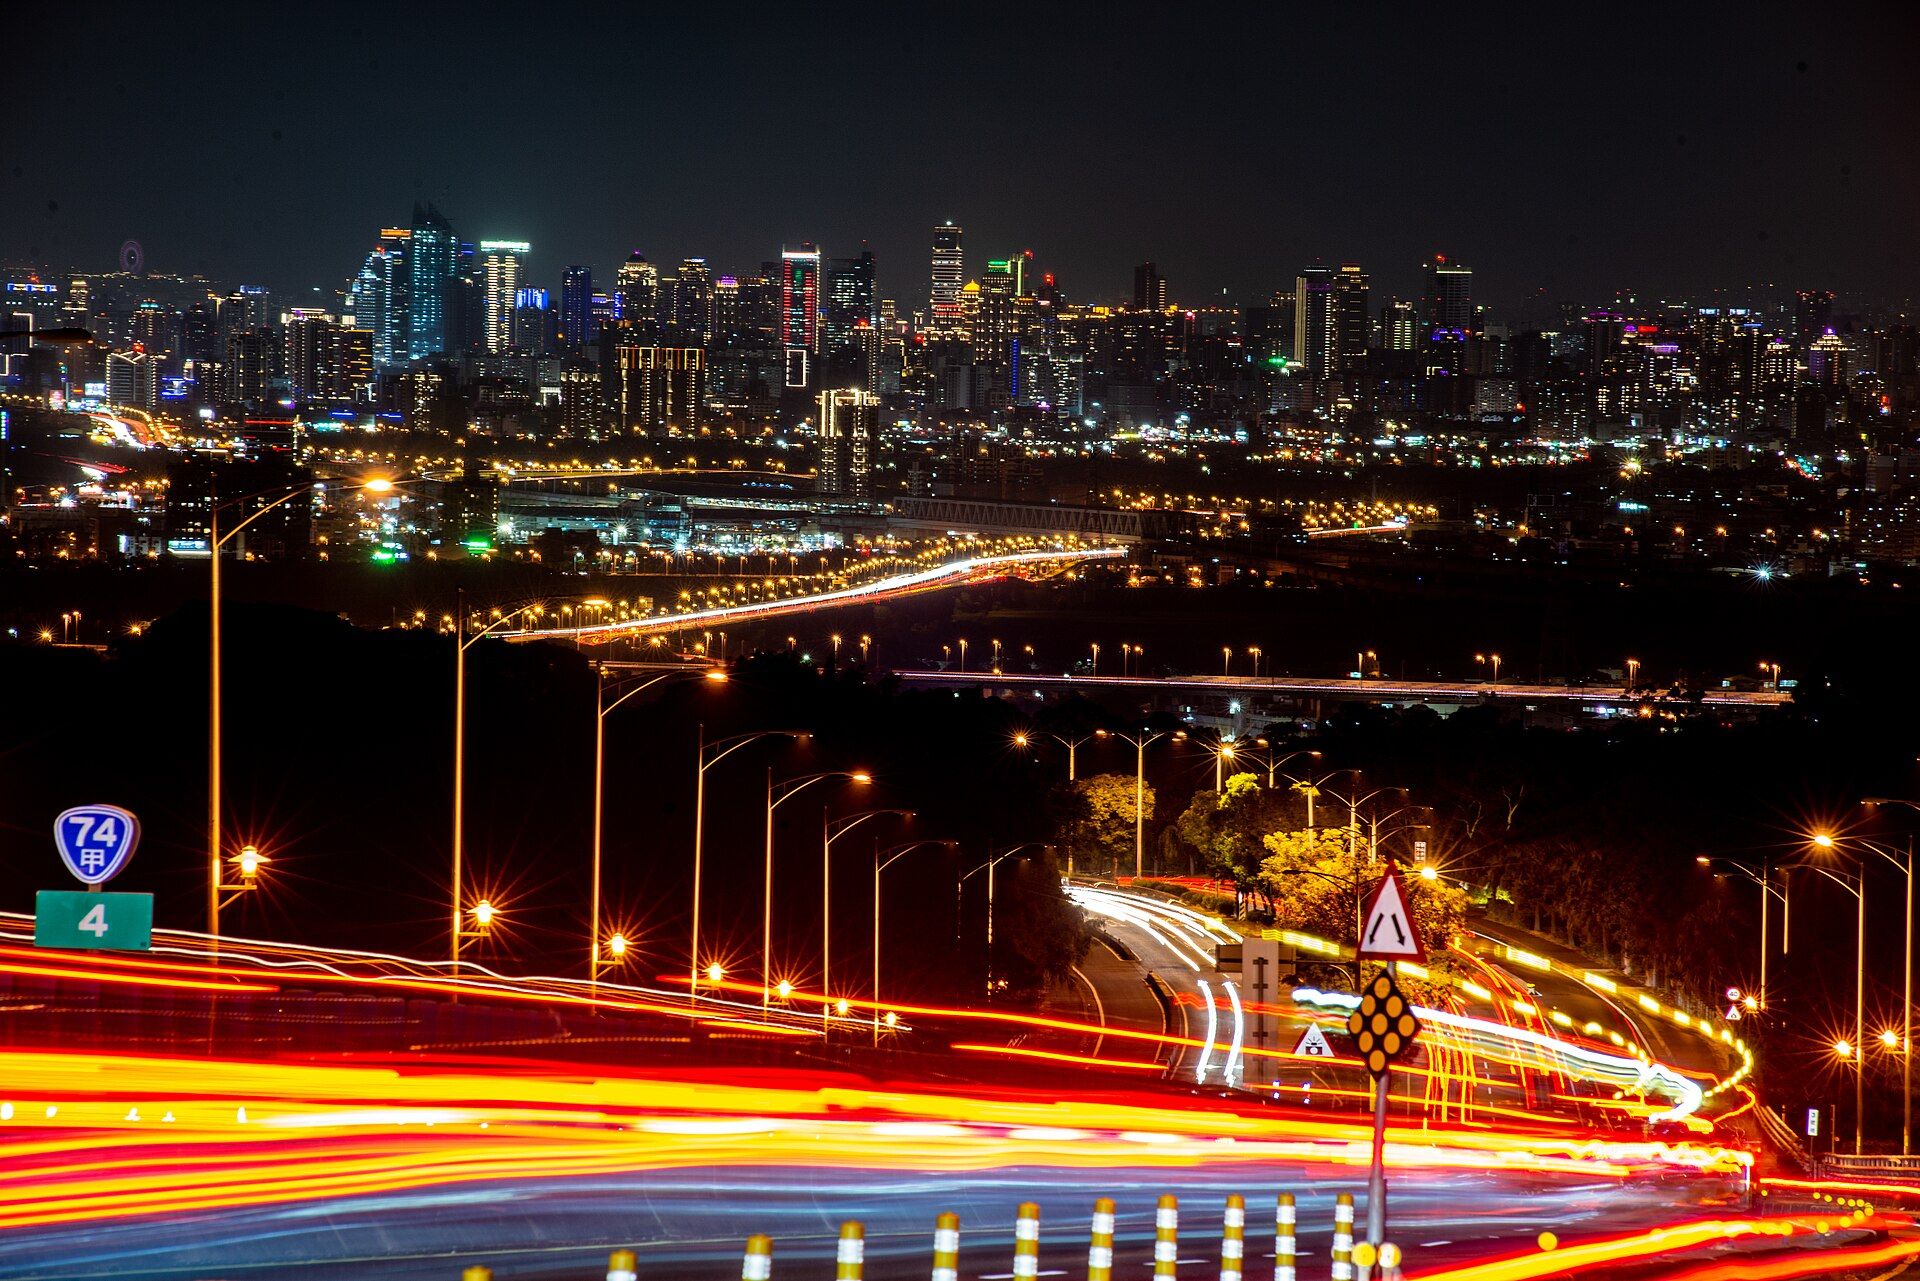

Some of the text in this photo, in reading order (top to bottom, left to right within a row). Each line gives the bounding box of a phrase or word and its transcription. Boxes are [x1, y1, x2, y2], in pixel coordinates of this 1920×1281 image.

[68, 816, 117, 847] 74
[79, 848, 105, 874] 甲
[78, 903, 109, 937] 4
